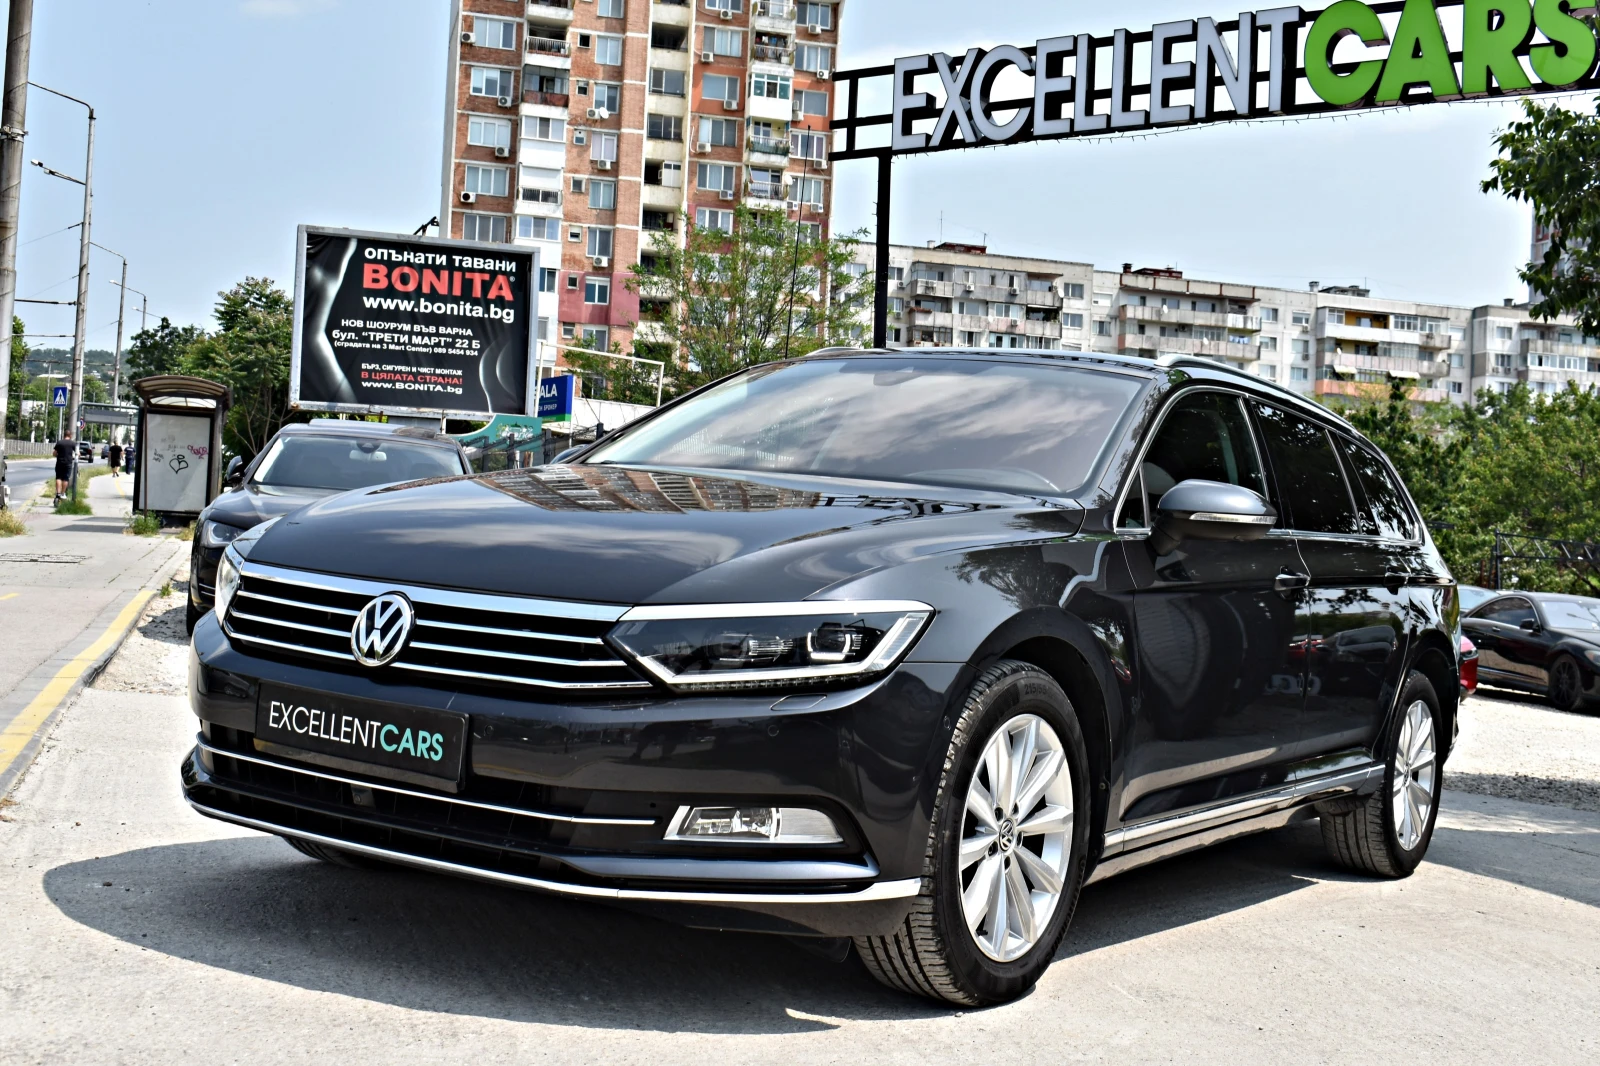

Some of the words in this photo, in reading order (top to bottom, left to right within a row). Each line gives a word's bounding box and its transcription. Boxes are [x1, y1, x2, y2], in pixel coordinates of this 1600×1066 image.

[364, 247, 447, 266] опънати
[452, 255, 516, 273] тавани
[362, 296, 515, 324] www.bonita.bg
[341, 319, 364, 328] НОВ
[366, 320, 411, 332] ШОУРУМ
[413, 324, 436, 333] ВЪВ
[438, 326, 474, 336] ВАРНА
[332, 329, 359, 341] бул.
[455, 338, 469, 348] 22
[472, 340, 481, 349] Б
[334, 340, 370, 348] (сградата
[388, 343, 405, 351] Mart
[406, 345, 432, 354] Center)
[382, 364, 411, 372] СИГУРЕН
[435, 368, 463, 376] МОНТАЖ
[361, 371, 369, 379] В
[371, 372, 415, 382] ЦЯЛАТА
[417, 375, 463, 385] СТРАНА!
[361, 381, 463, 395] www.BONITA.bg
